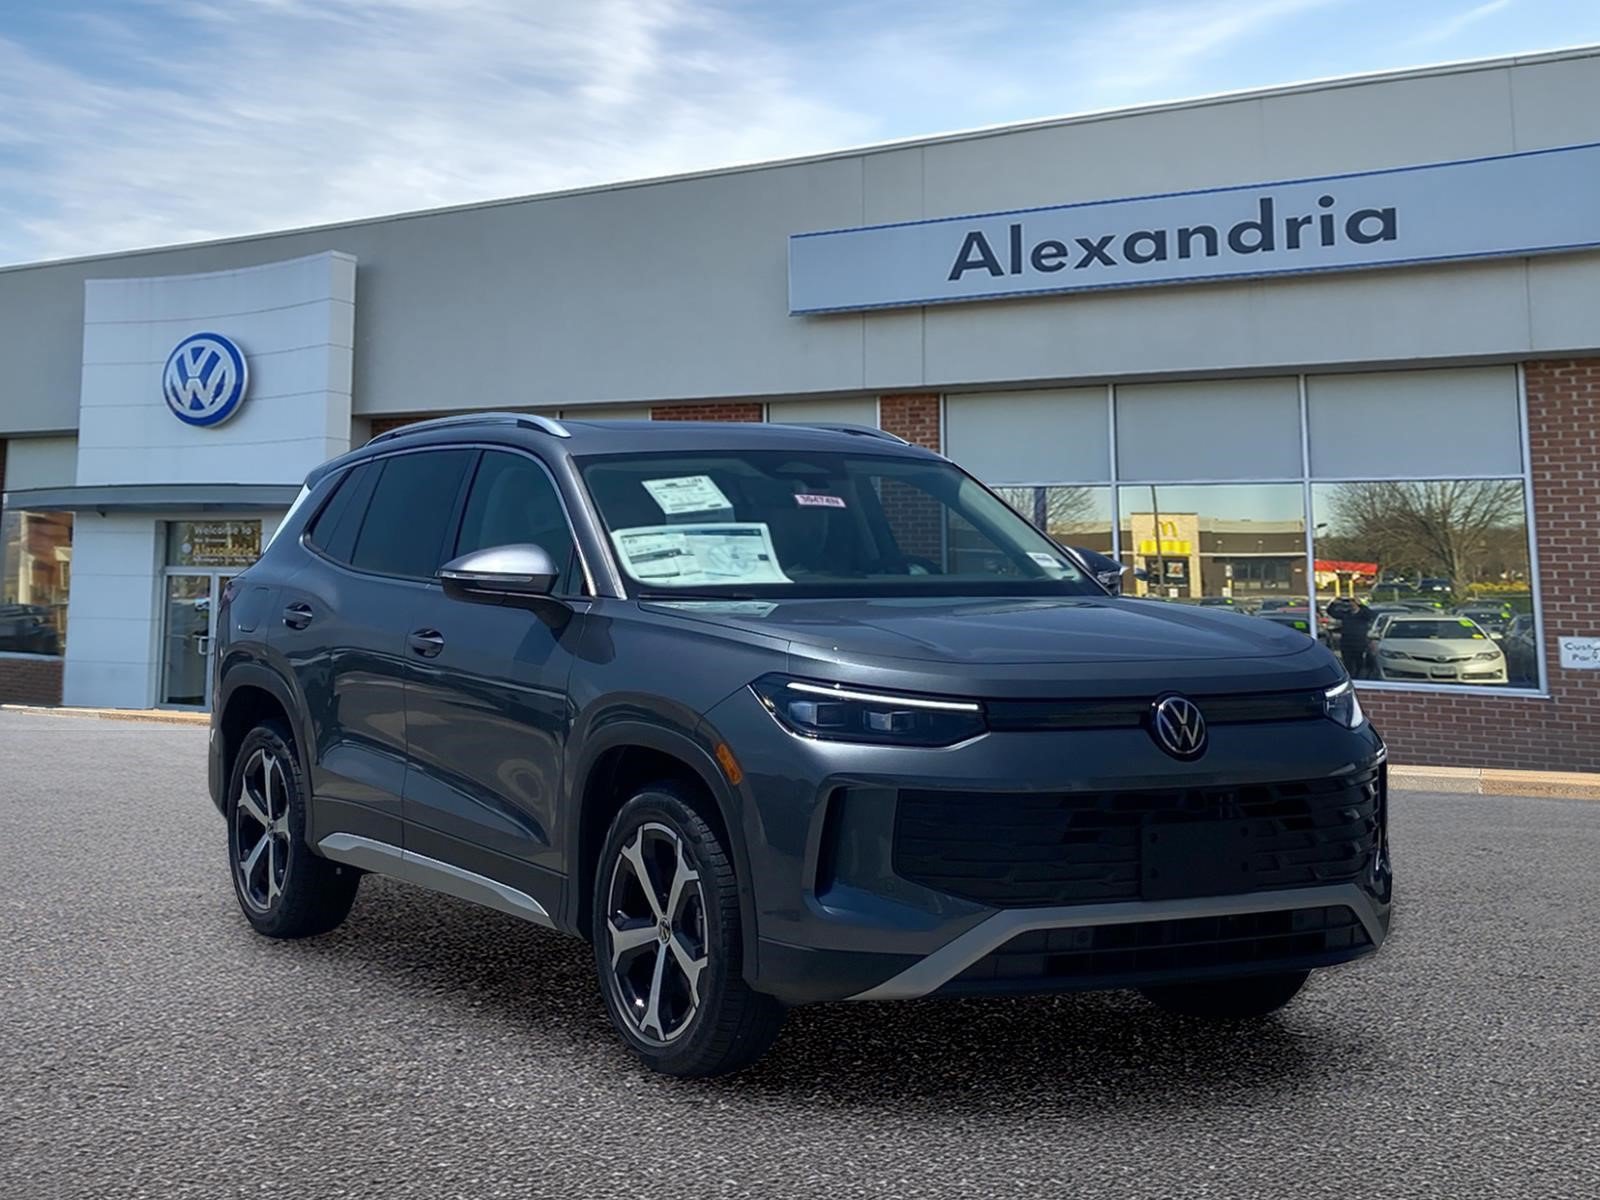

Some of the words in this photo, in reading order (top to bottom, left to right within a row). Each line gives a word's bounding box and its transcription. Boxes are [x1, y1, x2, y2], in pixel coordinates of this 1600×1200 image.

[948, 195, 1398, 281] Alexandria
[166, 339, 236, 418] VW
[1158, 697, 1204, 752] VW
